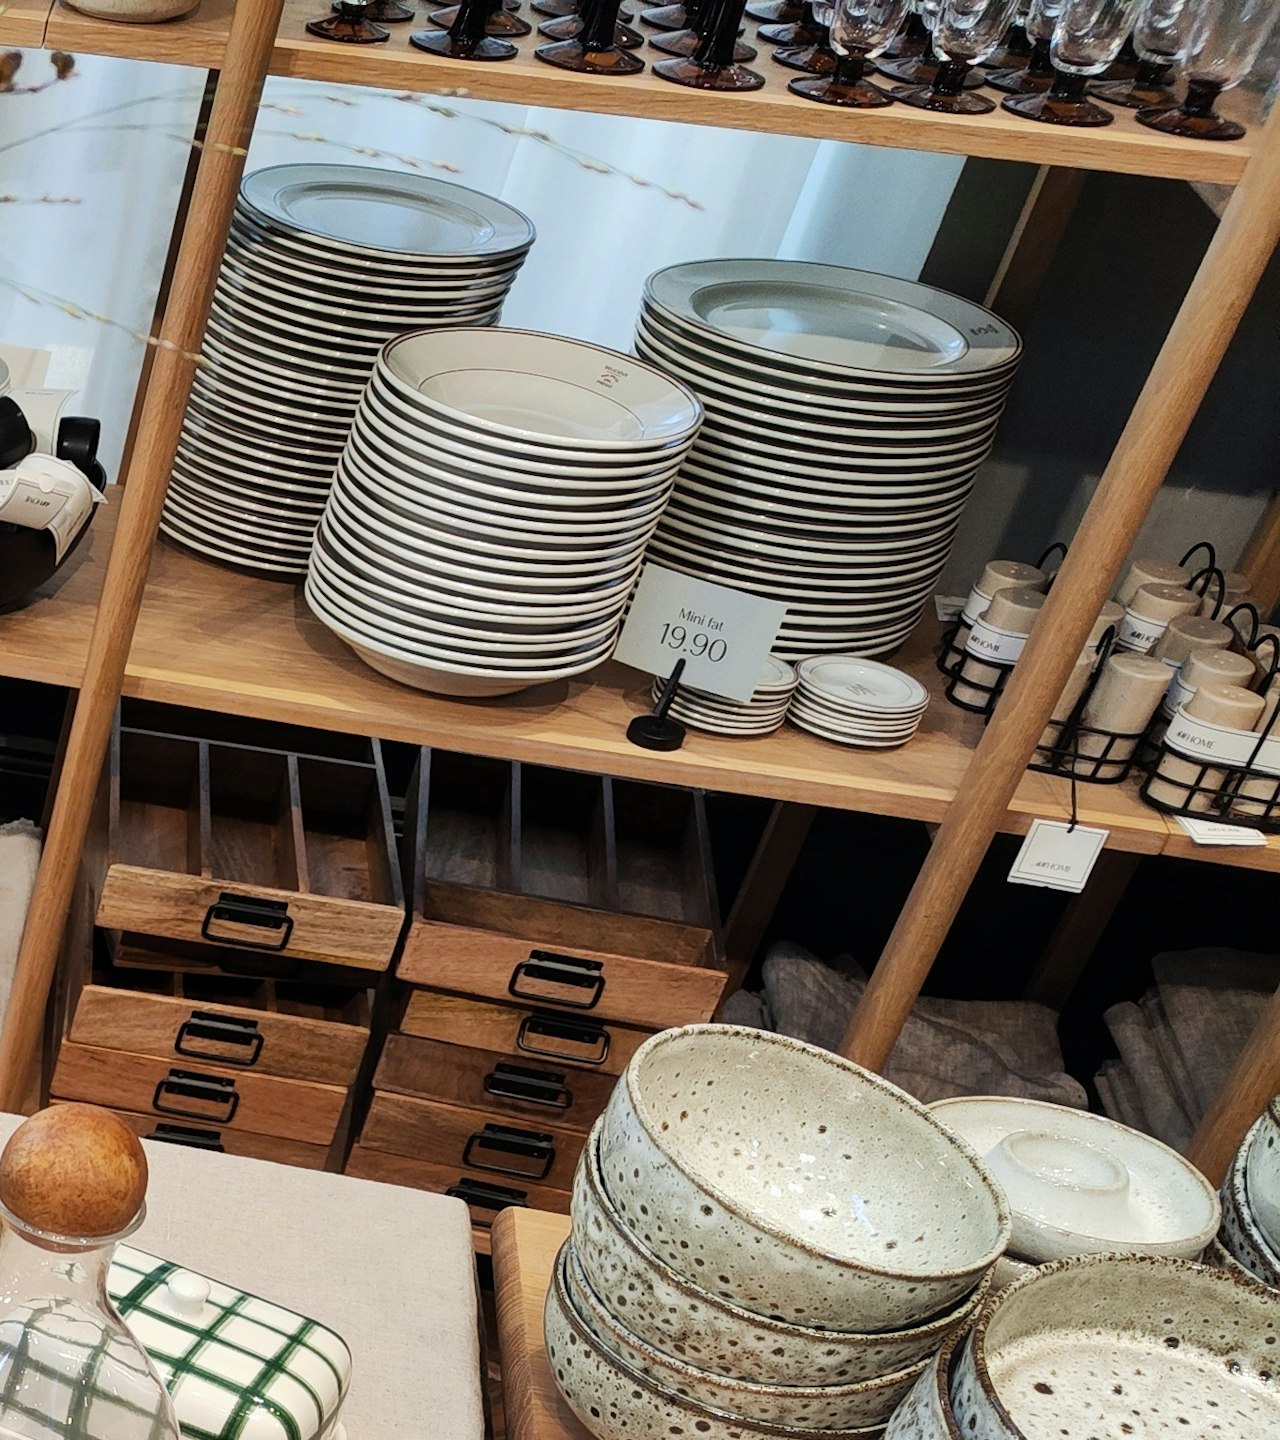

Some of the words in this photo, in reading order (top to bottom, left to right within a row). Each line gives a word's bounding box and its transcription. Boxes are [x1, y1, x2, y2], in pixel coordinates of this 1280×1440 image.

[678, 607, 706, 626] Mini
[707, 616, 725, 632] fat
[660, 622, 728, 663] 19.90
